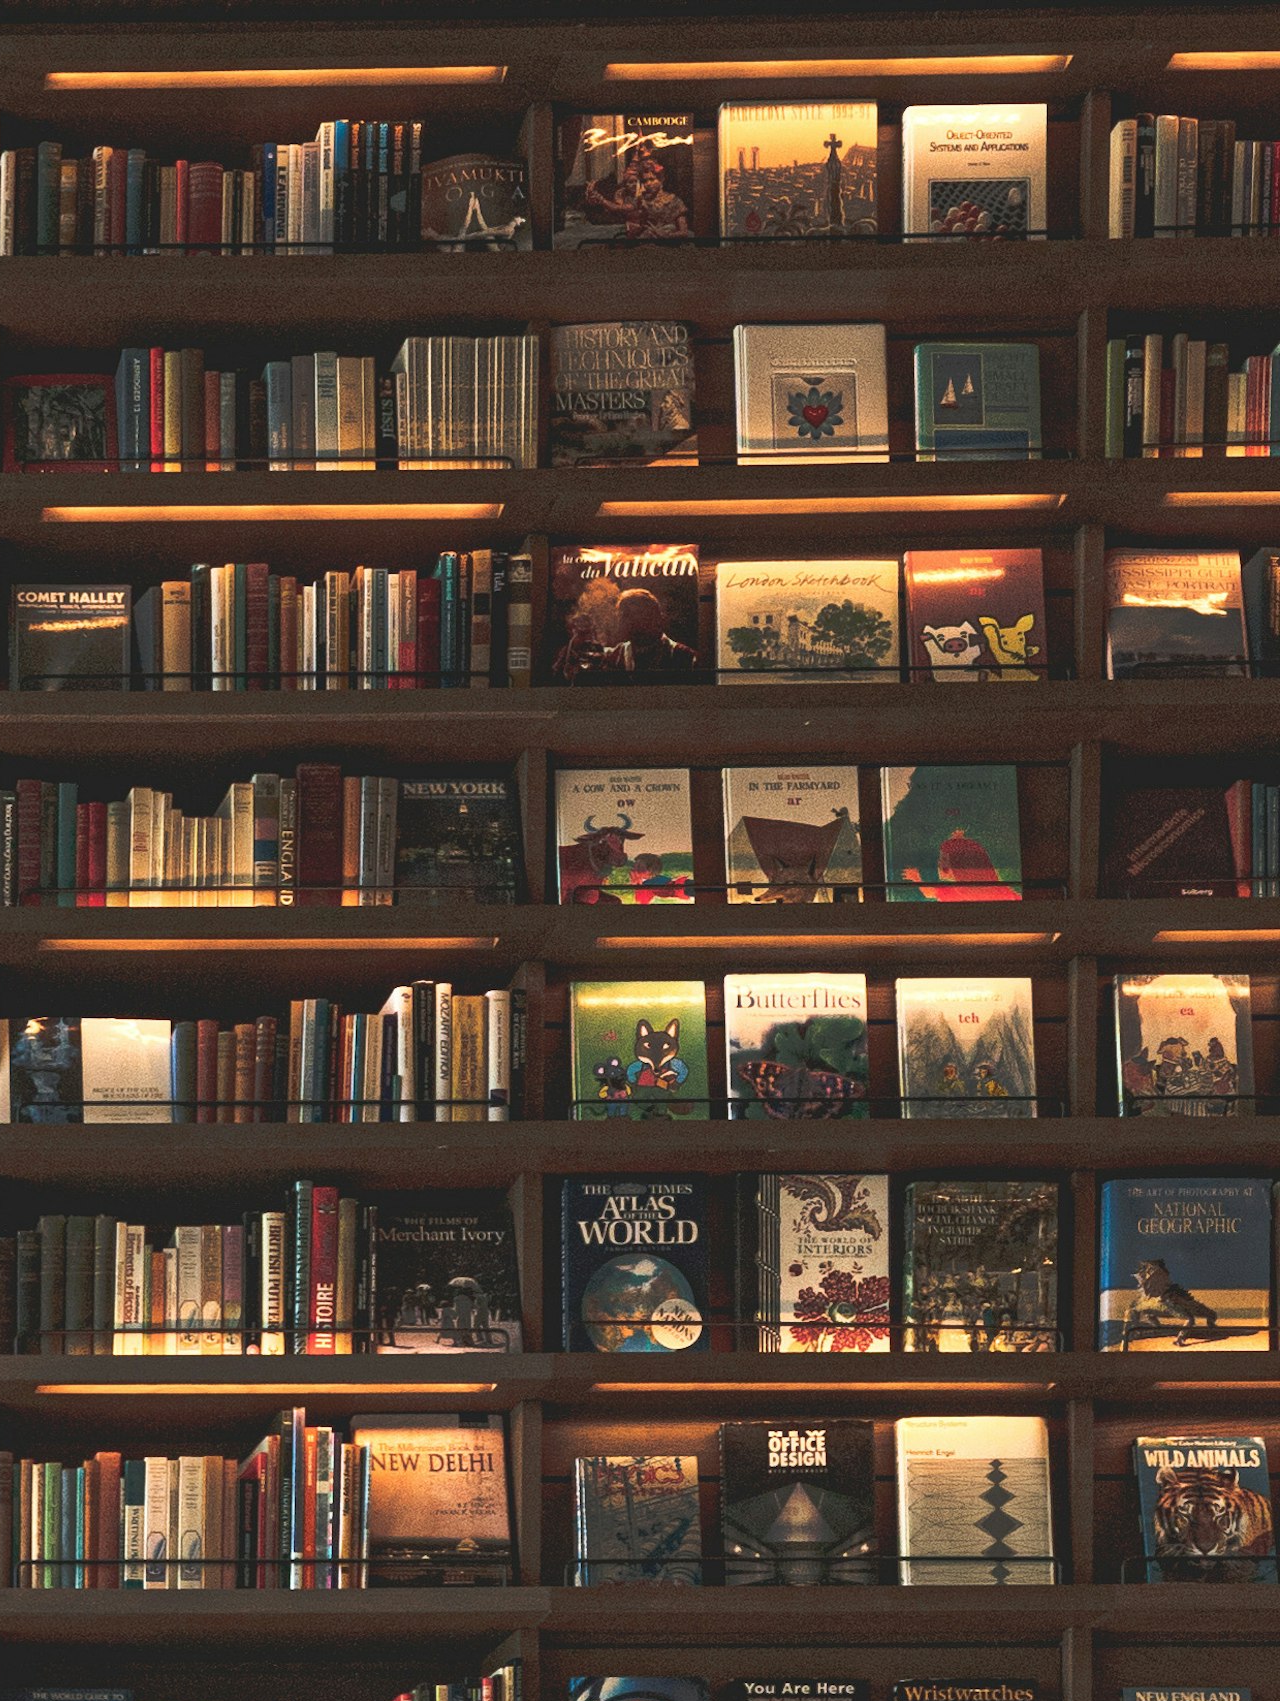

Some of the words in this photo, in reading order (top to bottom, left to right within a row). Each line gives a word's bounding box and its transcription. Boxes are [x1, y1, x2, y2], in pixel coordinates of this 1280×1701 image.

[627, 115, 689, 127] CAMBODGE
[16, 591, 67, 603] COMET
[69, 591, 125, 603] HALLEY
[403, 782, 447, 794] NEW
[450, 782, 506, 794] YORK
[748, 782, 760, 791] IN
[764, 782, 783, 791] THE
[787, 782, 840, 791] FARMYARD
[736, 986, 862, 1009] Butterflies
[582, 1184, 611, 1195] THE
[647, 1184, 693, 1195] TIMES
[601, 1195, 676, 1220] ATLAS
[1153, 1201, 1222, 1218] NATIONAL
[578, 1220, 699, 1246] WORLD
[1137, 1218, 1242, 1234] GEOGRAPHIC
[378, 1227, 453, 1242] Merchant
[457, 1227, 505, 1246] Ivory
[768, 1438, 826, 1452] OFFICE
[371, 1452, 420, 1472] NEW
[429, 1452, 494, 1473] DELHI
[769, 1452, 827, 1467] DESIGN
[1143, 1449, 1185, 1467] WILD
[1186, 1450, 1260, 1467] ANIMALS
[744, 1682, 776, 1695] You
[781, 1682, 811, 1695] Are
[816, 1682, 855, 1695] Here
[905, 1686, 1034, 1701] Wristwatches
